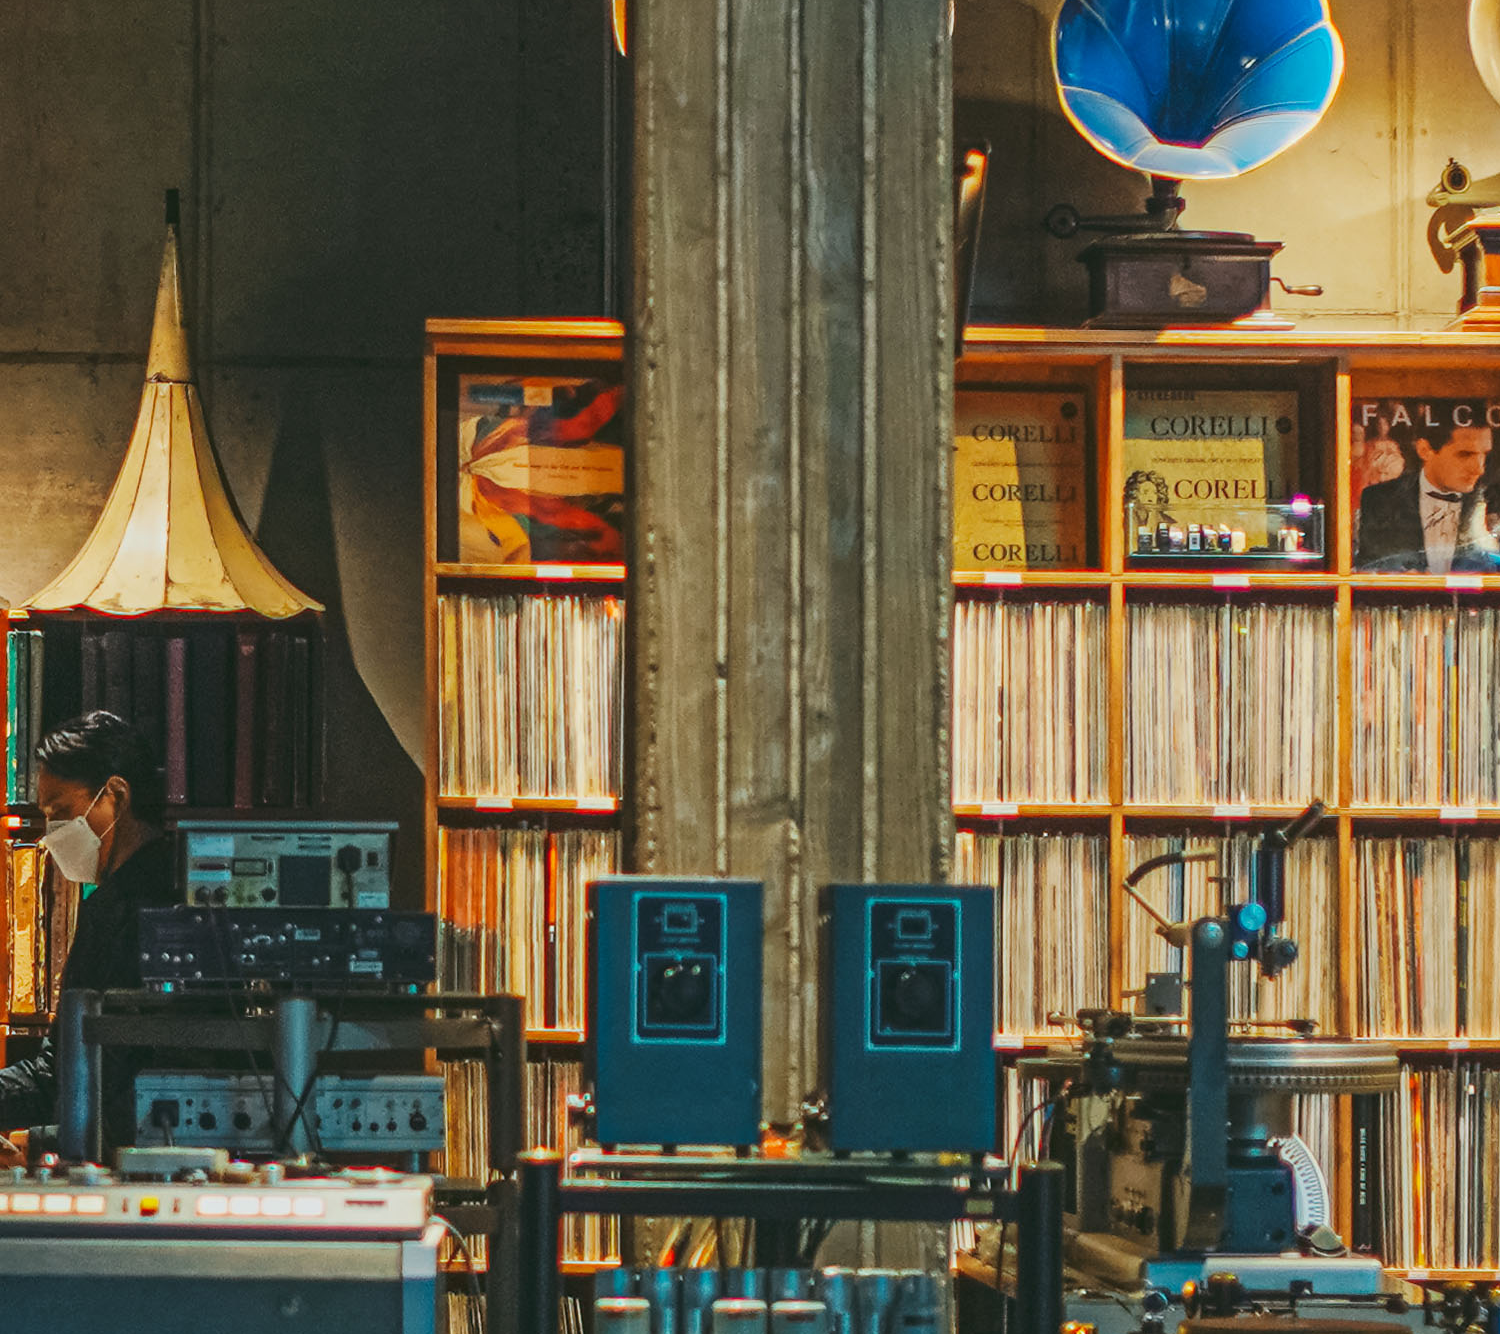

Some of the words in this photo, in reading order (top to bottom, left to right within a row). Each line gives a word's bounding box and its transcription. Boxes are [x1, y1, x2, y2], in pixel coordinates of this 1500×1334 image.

[972, 424, 1076, 442] CORELLI
[1151, 416, 1268, 436] CORELLI
[972, 483, 1077, 502] CORELLI
[1174, 478, 1290, 500] CORELLI
[973, 543, 1078, 562] CORELLI
